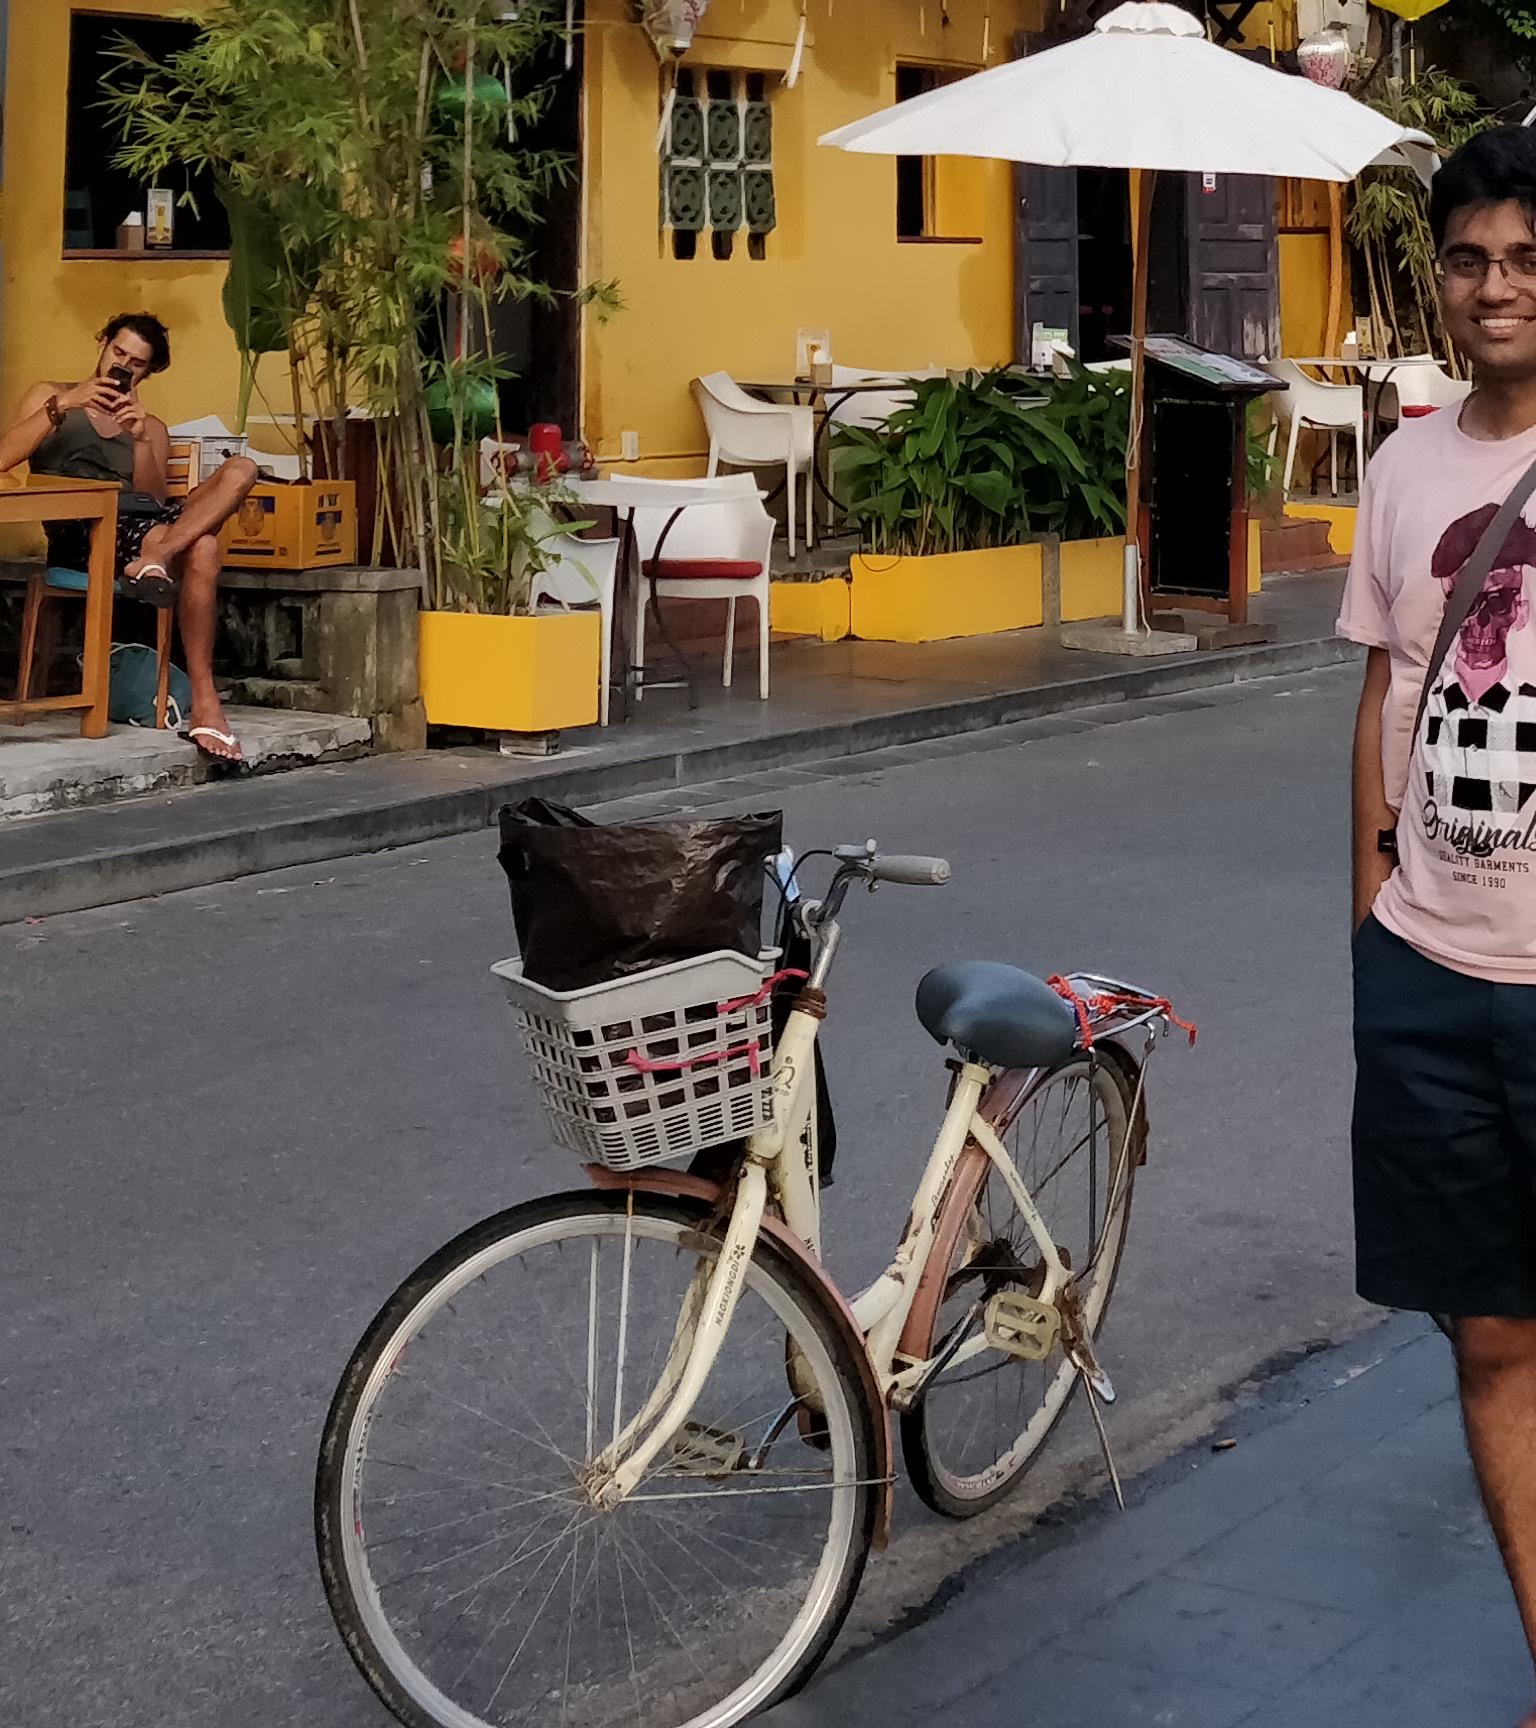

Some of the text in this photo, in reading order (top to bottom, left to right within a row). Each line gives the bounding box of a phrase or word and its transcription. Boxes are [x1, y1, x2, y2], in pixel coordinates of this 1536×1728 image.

[1474, 858, 1530, 873] GARMENTS
[1452, 871, 1478, 885] SINCE
[715, 1260, 740, 1327] HAOXIONGDI
